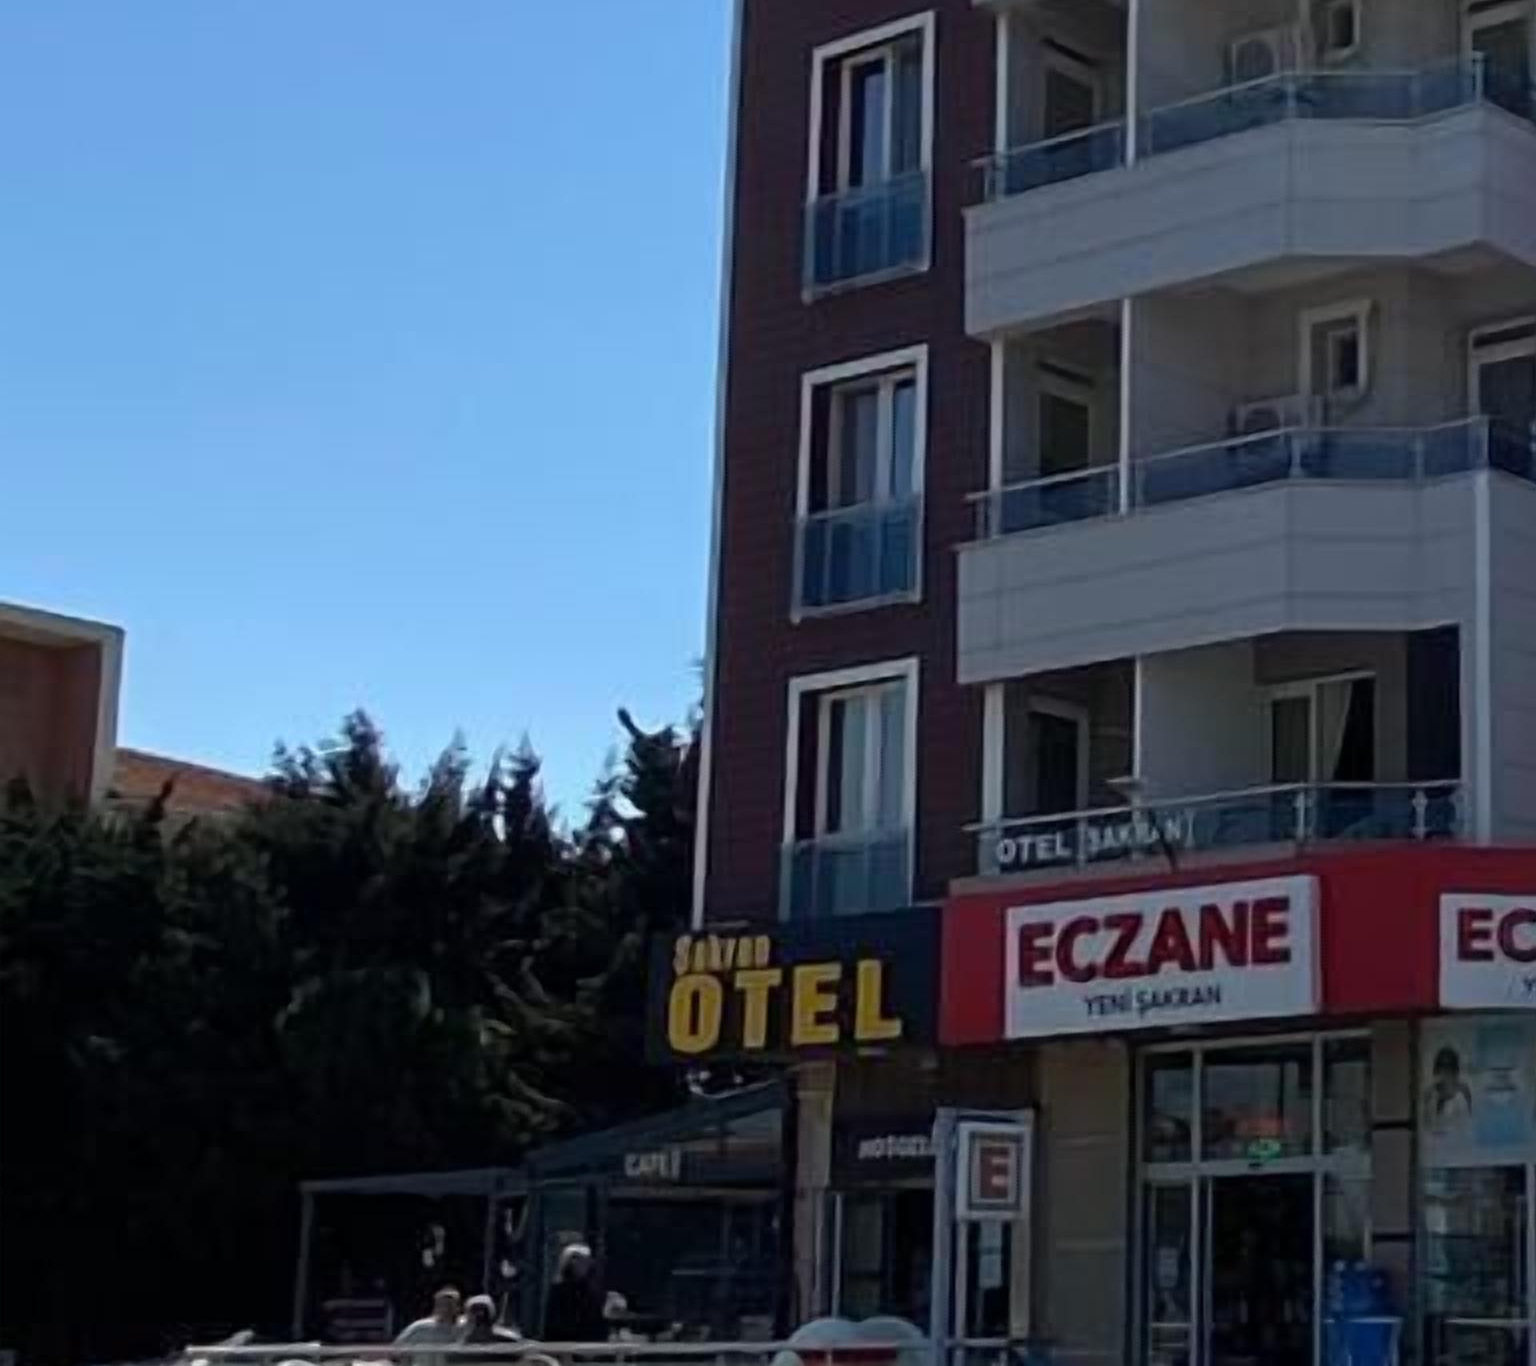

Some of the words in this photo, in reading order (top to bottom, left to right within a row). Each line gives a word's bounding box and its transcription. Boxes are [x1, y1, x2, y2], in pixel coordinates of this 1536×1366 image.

[997, 829, 1072, 865] OTEL
[1018, 896, 1292, 988] ECZANE
[668, 958, 903, 1054] OTEL
[1084, 988, 1133, 1017] YENİ
[979, 1146, 1010, 1200] E
